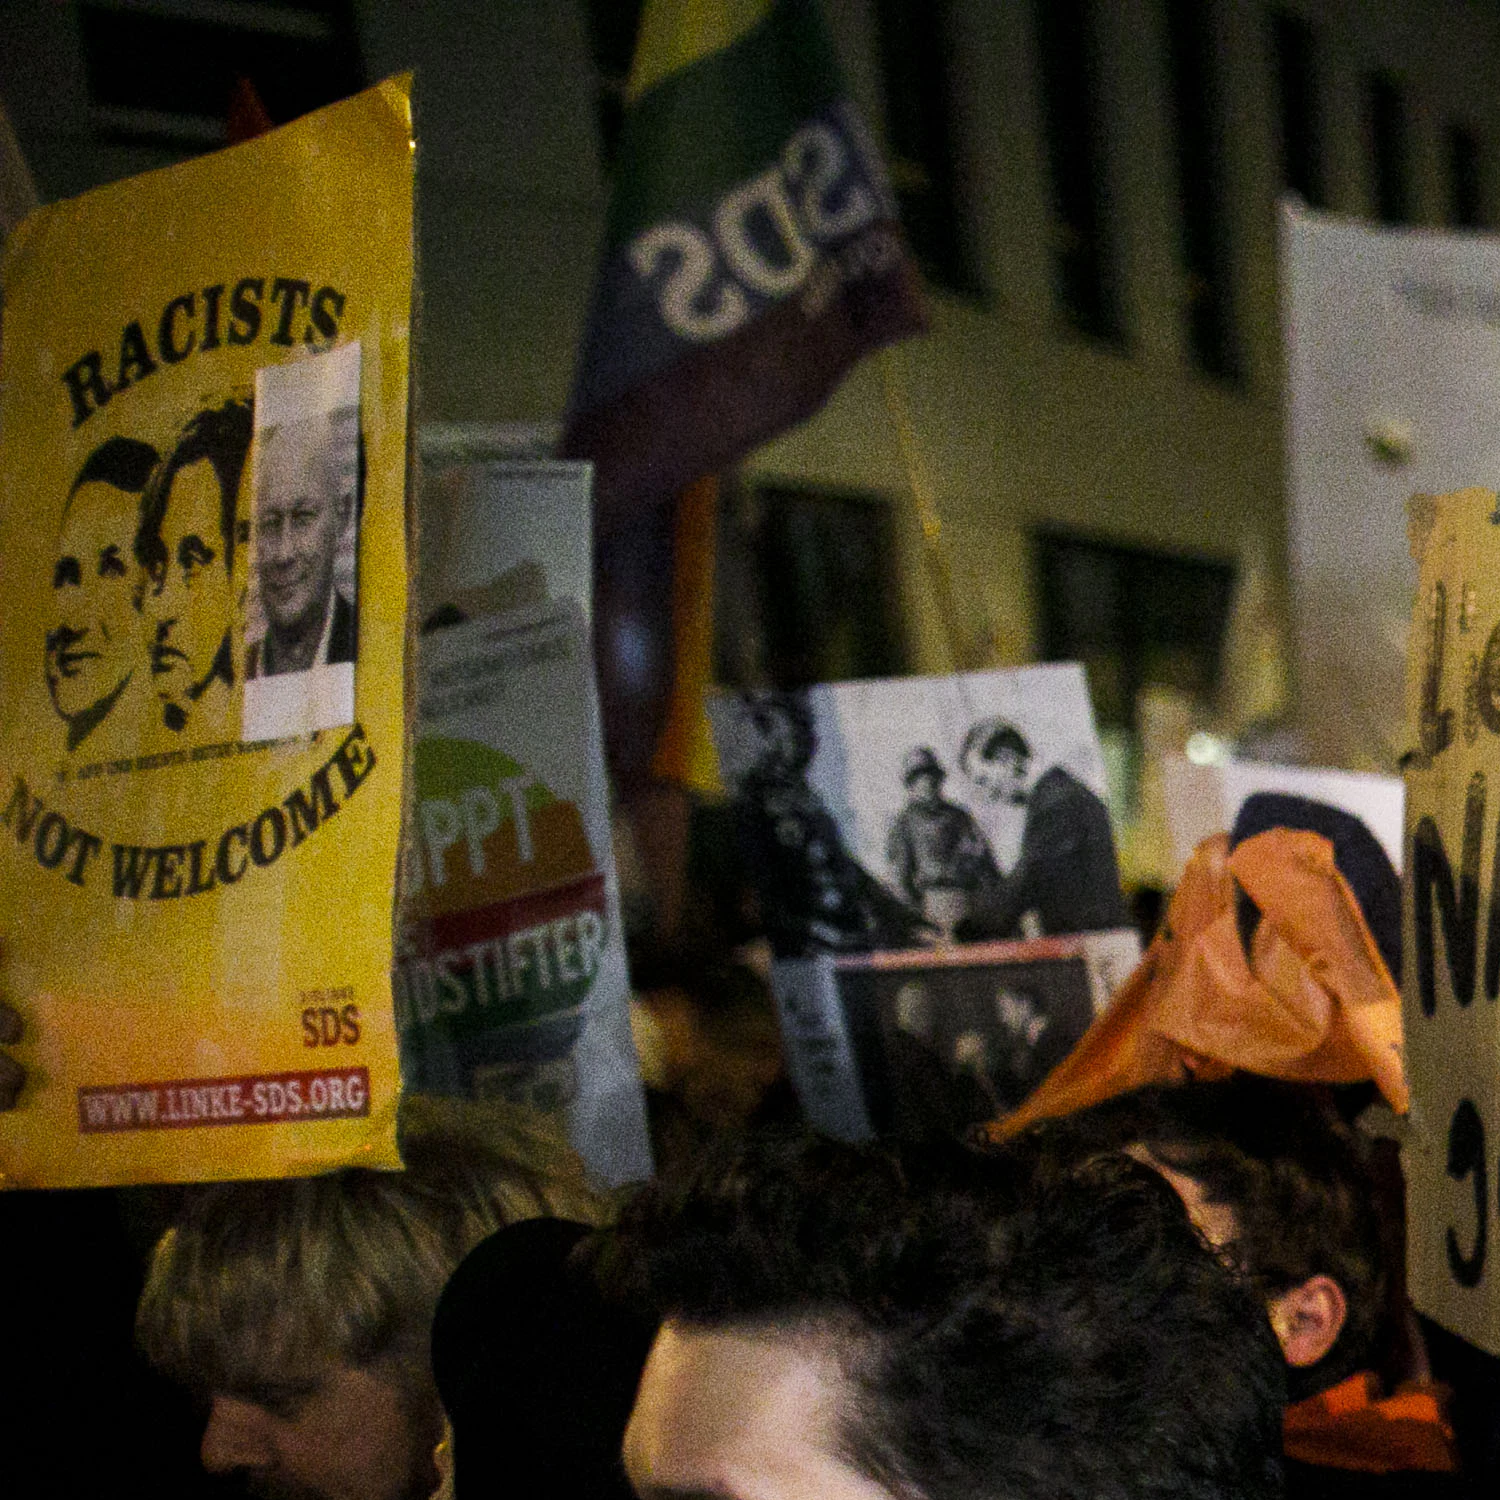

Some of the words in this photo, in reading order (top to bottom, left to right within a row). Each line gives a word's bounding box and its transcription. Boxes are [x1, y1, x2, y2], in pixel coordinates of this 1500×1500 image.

[62, 277, 346, 430] RACISTS
[2, 774, 102, 887] NOT
[112, 722, 377, 900] WELCOME
[302, 1003, 362, 1049] SDS
[79, 1075, 365, 1126] WWW.LINKE-SDS.ORG
